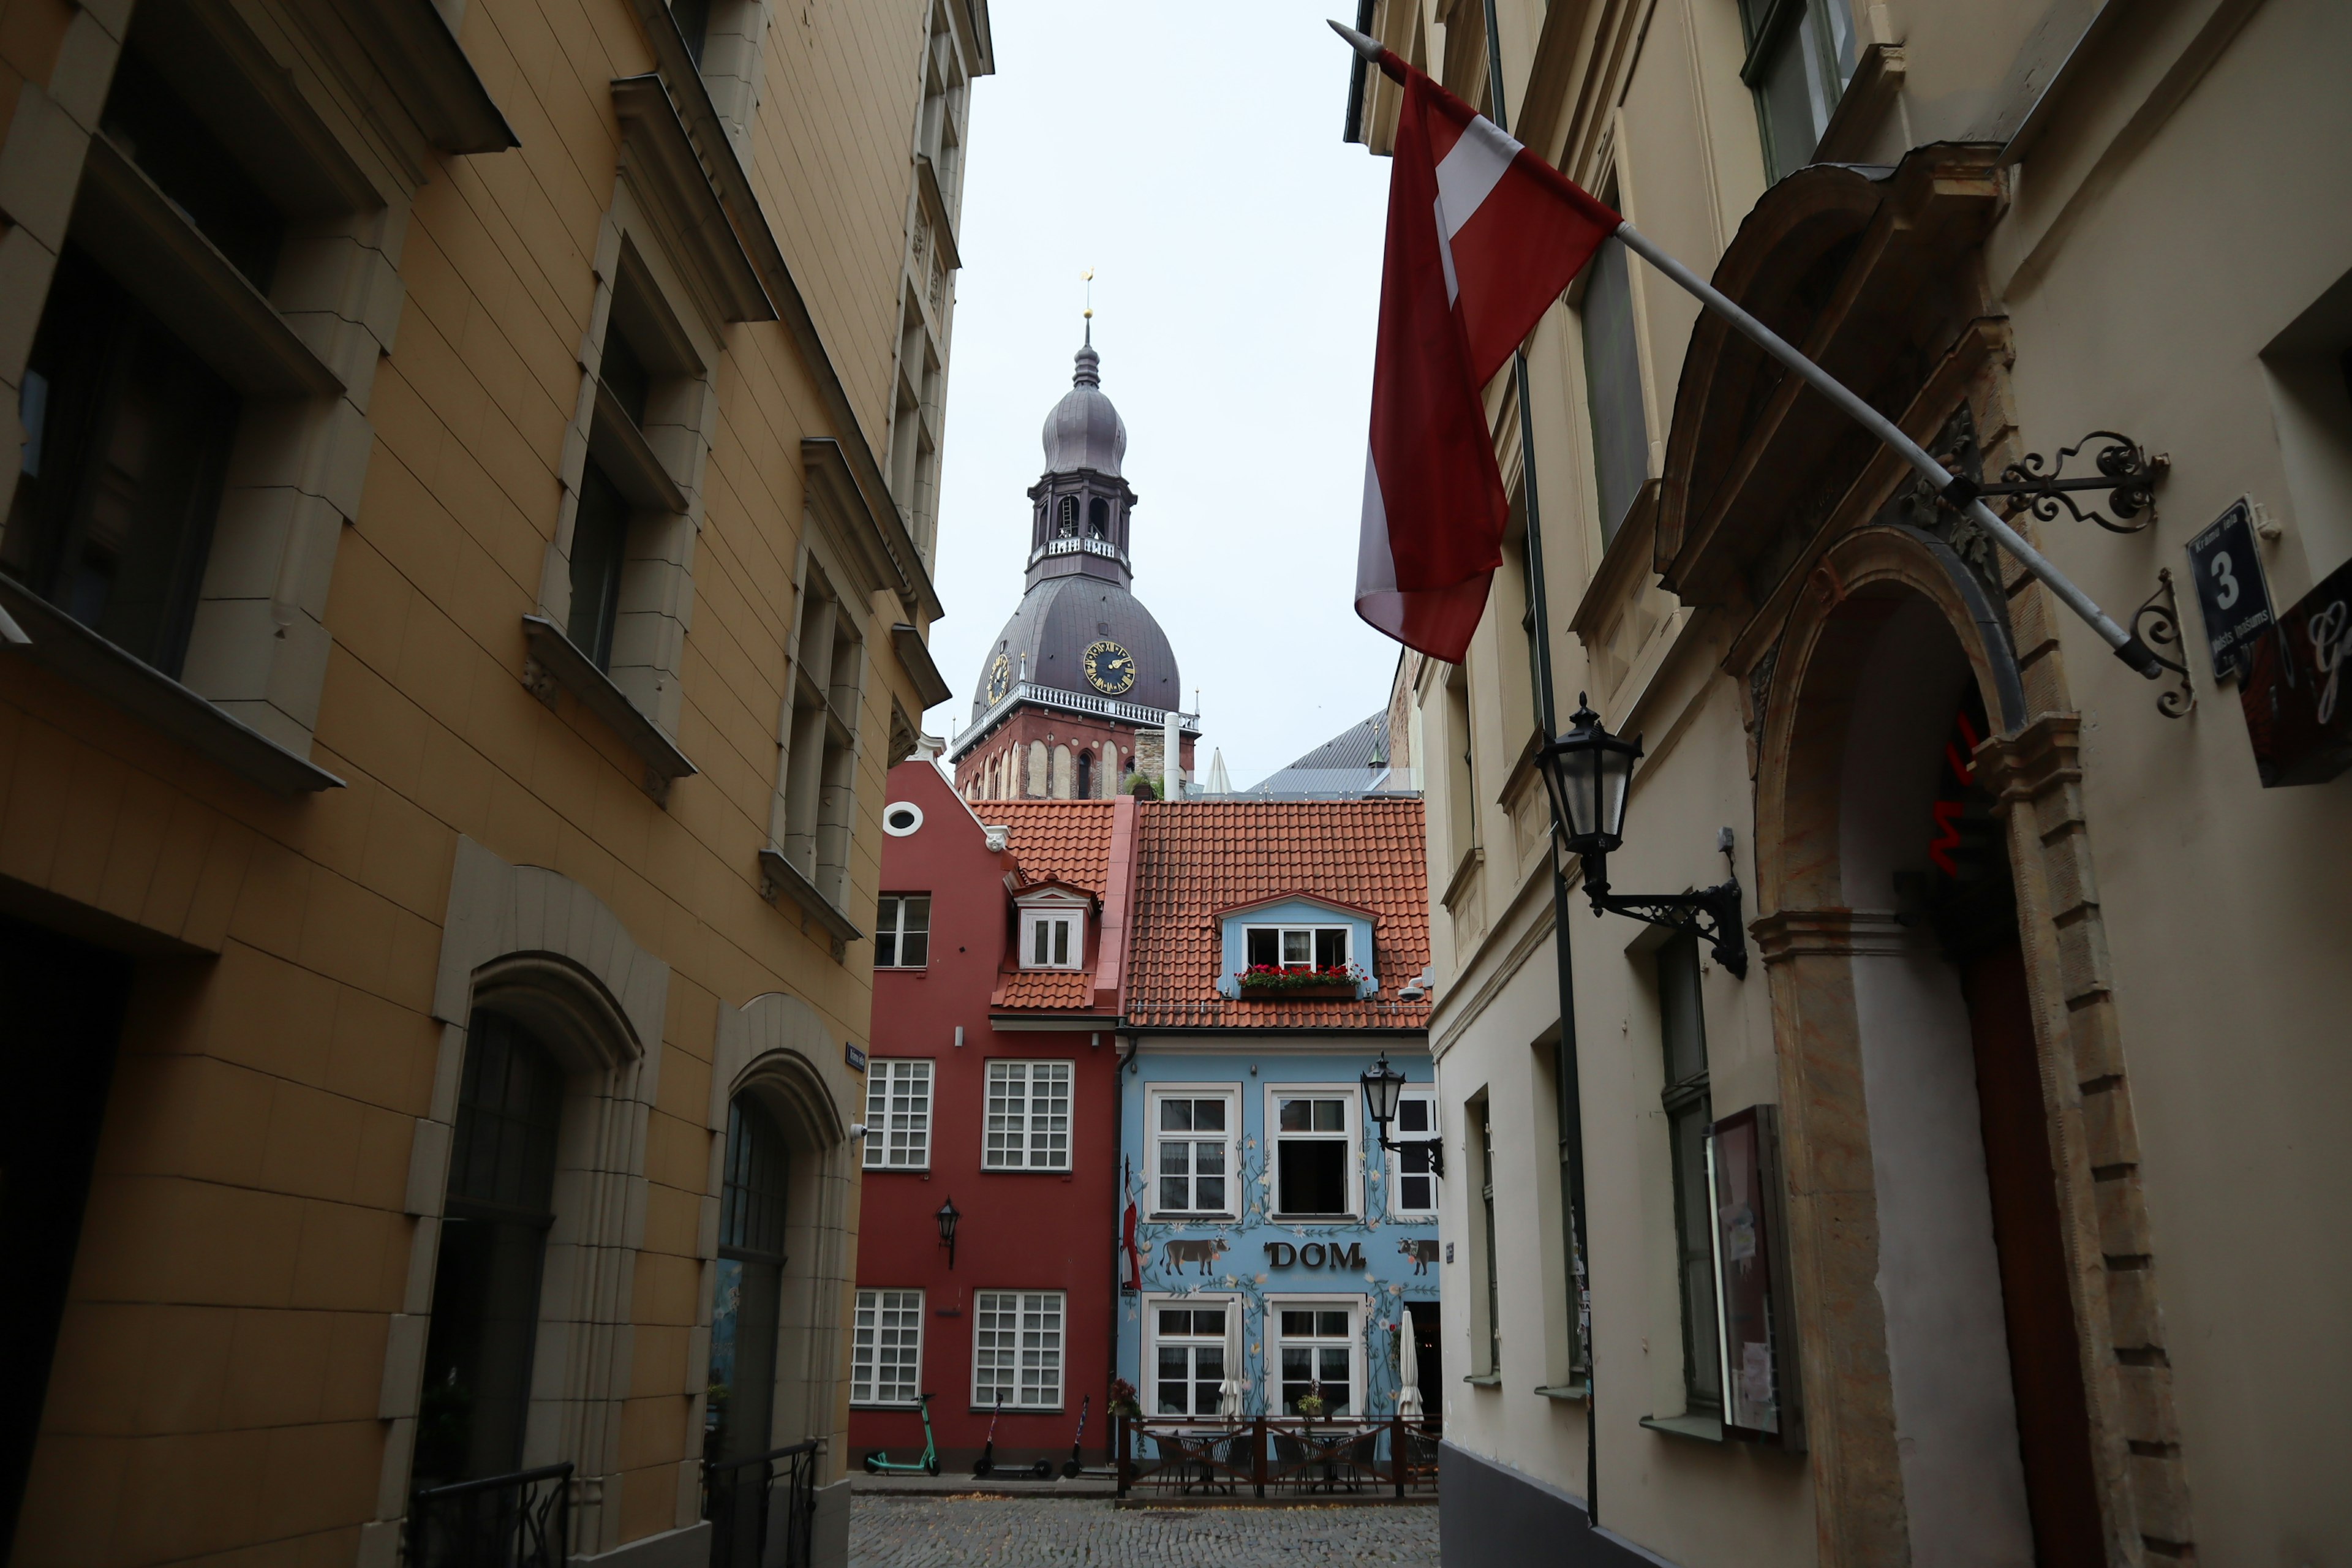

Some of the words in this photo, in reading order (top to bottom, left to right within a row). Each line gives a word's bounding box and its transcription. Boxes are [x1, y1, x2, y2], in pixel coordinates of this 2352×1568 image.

[2223, 513, 2238, 531] iela
[2211, 551, 2240, 611] 3
[1264, 1242, 1366, 1268] DOM
